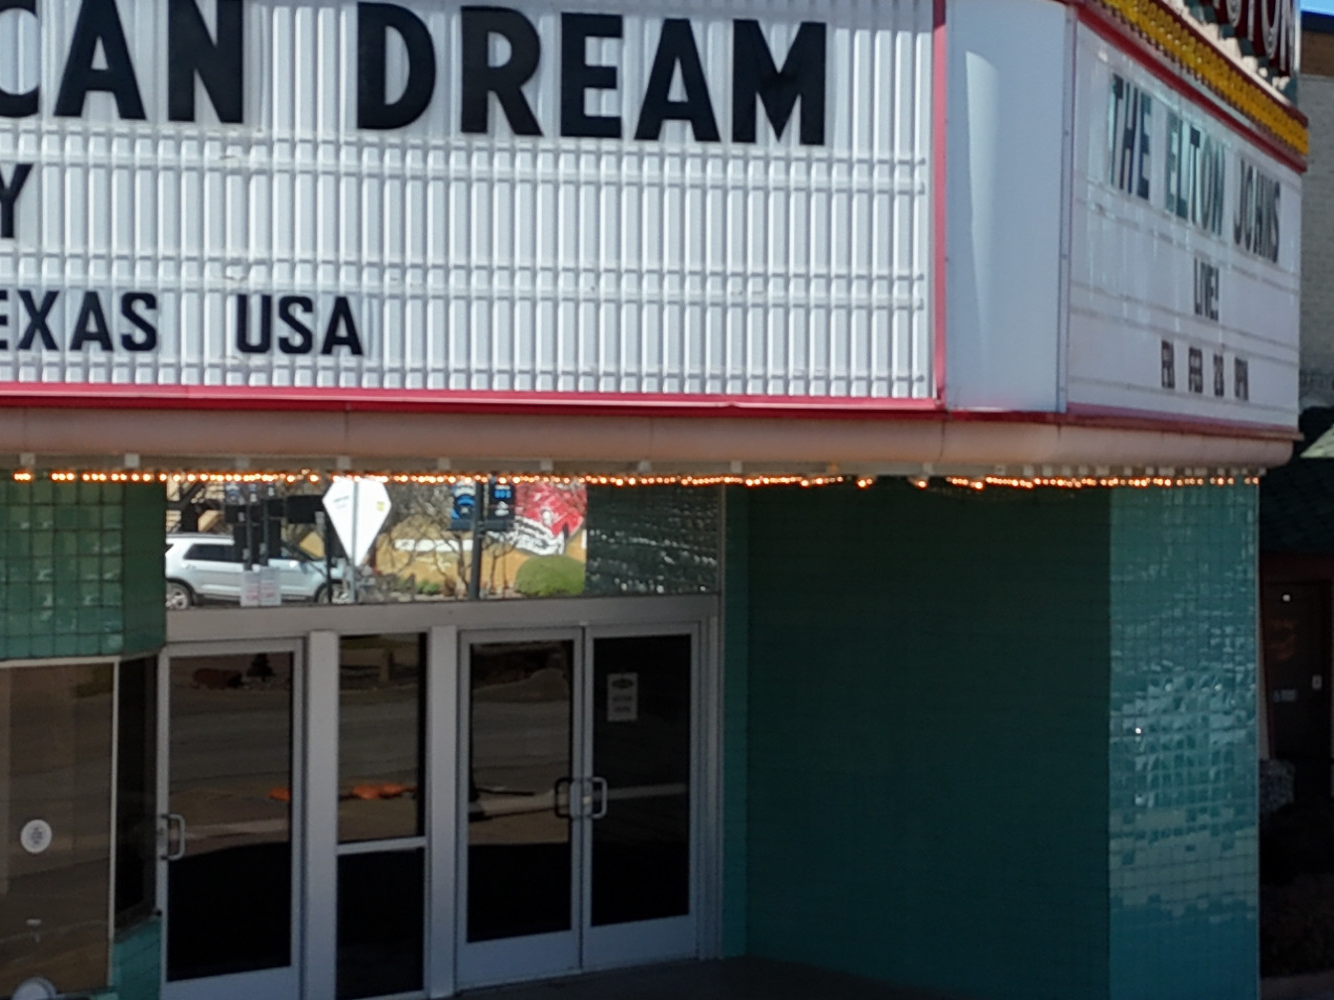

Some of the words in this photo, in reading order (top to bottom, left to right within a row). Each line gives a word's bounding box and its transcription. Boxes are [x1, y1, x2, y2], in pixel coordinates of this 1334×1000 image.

[357, 1, 827, 147] DREAM
[1108, 74, 1152, 200] THE
[1166, 111, 1226, 237] ELTON
[1234, 158, 1281, 264] JOHNS
[235, 293, 364, 357] USA
